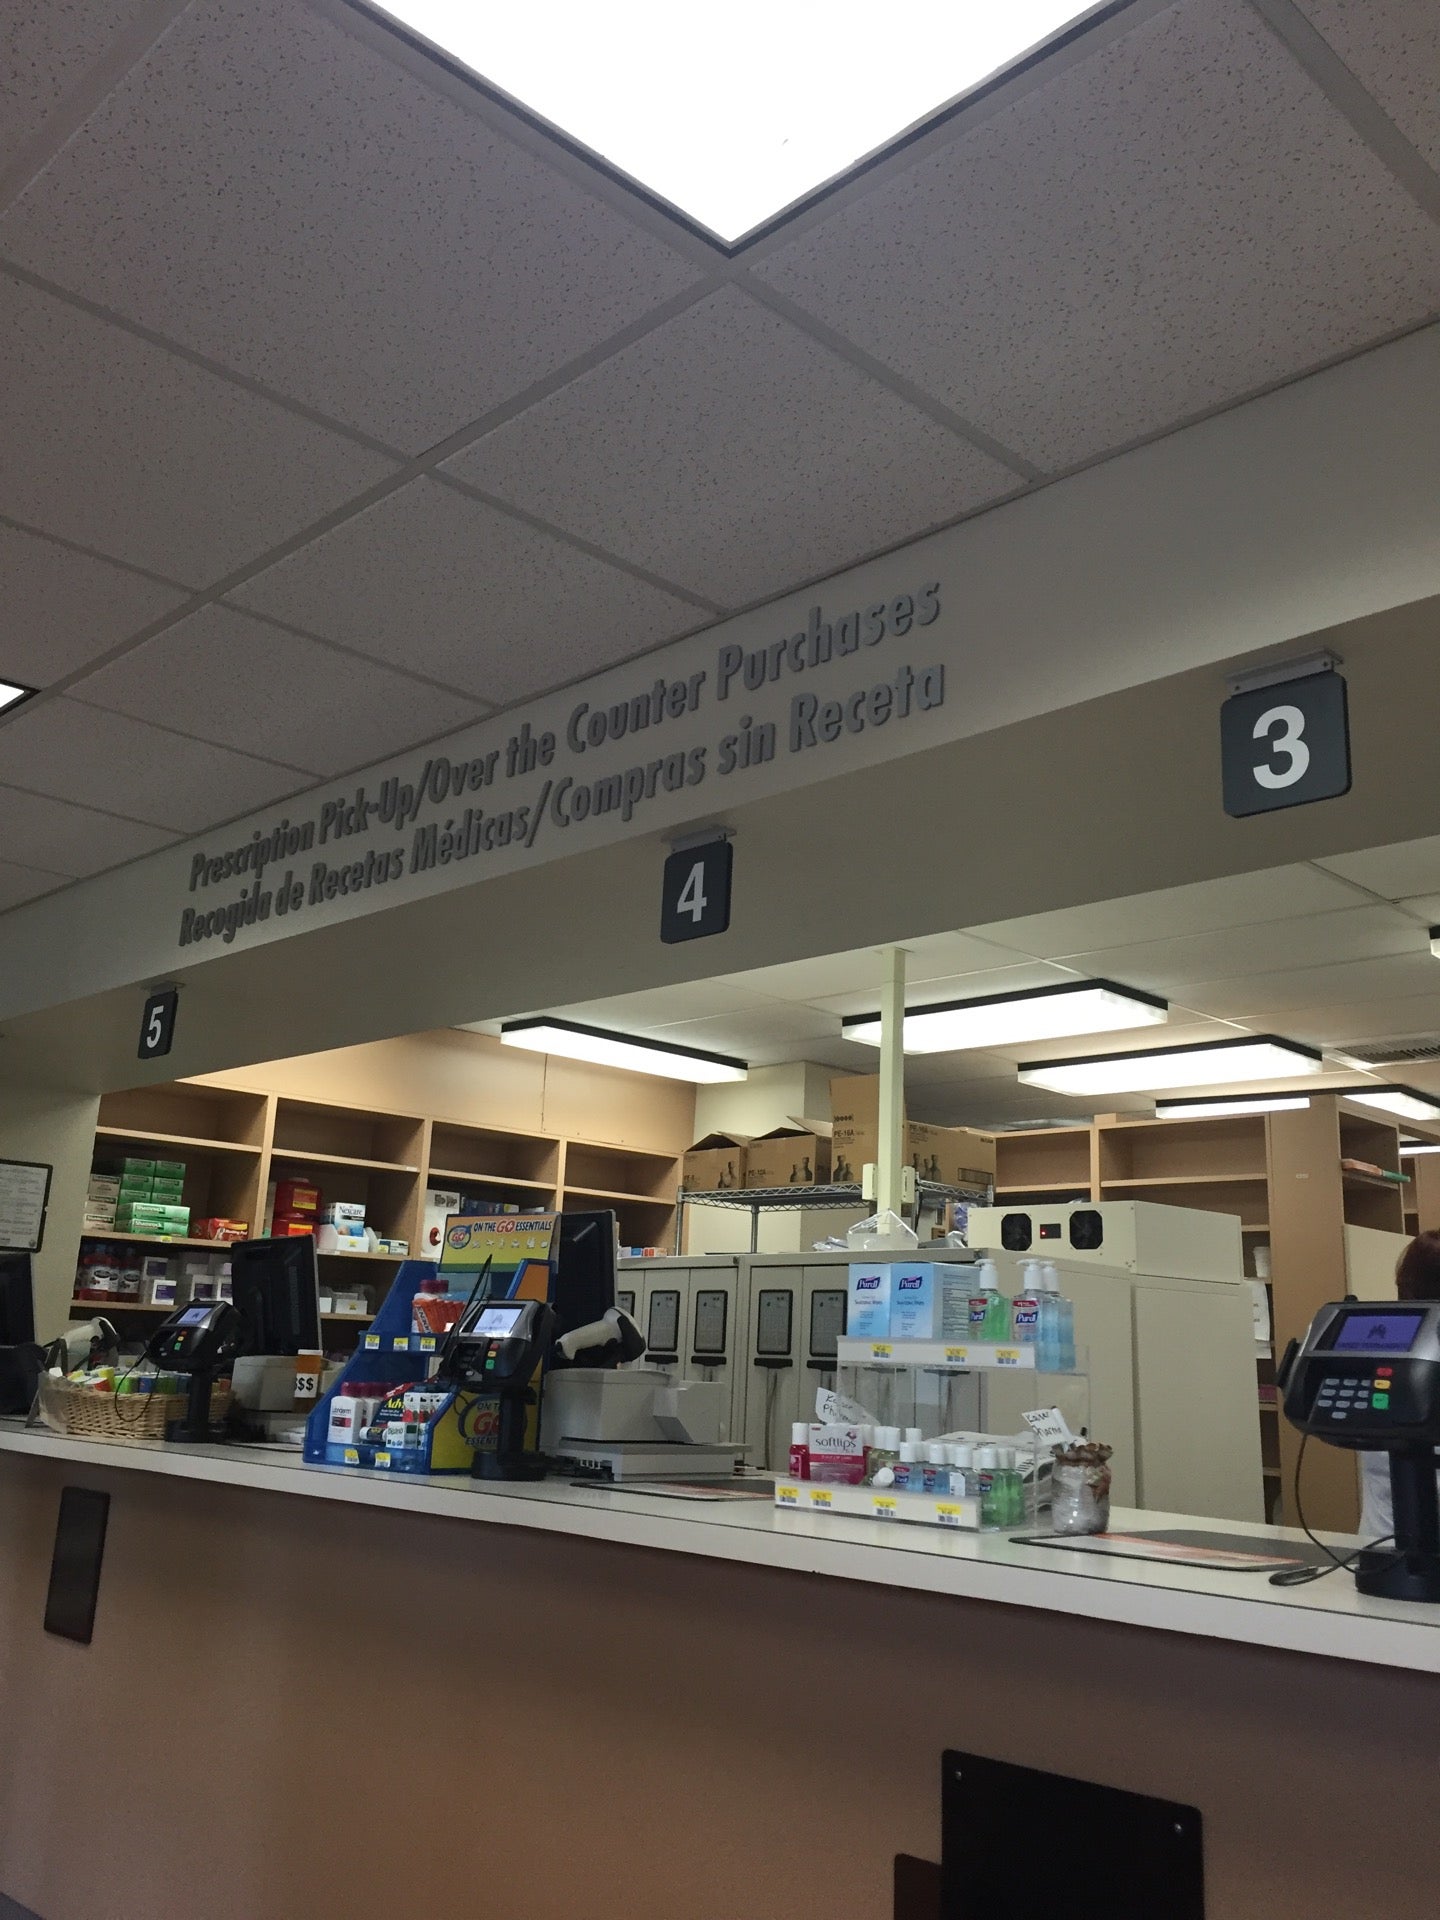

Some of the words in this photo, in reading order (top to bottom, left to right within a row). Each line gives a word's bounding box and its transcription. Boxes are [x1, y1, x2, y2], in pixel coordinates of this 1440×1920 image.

[189, 820, 314, 891] Prescription
[319, 750, 499, 844] Pick-Up/Over
[506, 723, 556, 777] the
[567, 671, 706, 753] Counter
[717, 582, 940, 700] Purchases
[1253, 705, 1310, 790] 3
[179, 880, 272, 946] Recogida
[275, 871, 304, 916] de
[308, 848, 404, 905] Recetas
[410, 746, 707, 873] Médicas/Compras
[717, 715, 775, 775] sin
[789, 664, 945, 752] Receta
[676, 861, 707, 922] 4
[146, 1005, 164, 1048] 5
[339, 1205, 363, 1216] Nexcare
[473, 1222, 483, 1232] ON
[484, 1221, 496, 1232] THE
[496, 1220, 516, 1233] GO
[516, 1220, 552, 1232] ESSENTIALS
[859, 1279, 879, 1289] Purell
[901, 1279, 921, 1289] Purell
[1017, 1312, 1037, 1322] Purell
[384, 1397, 405, 1409] Adv
[465, 1436, 498, 1446] ESSENT
[815, 1437, 856, 1448] softlips
